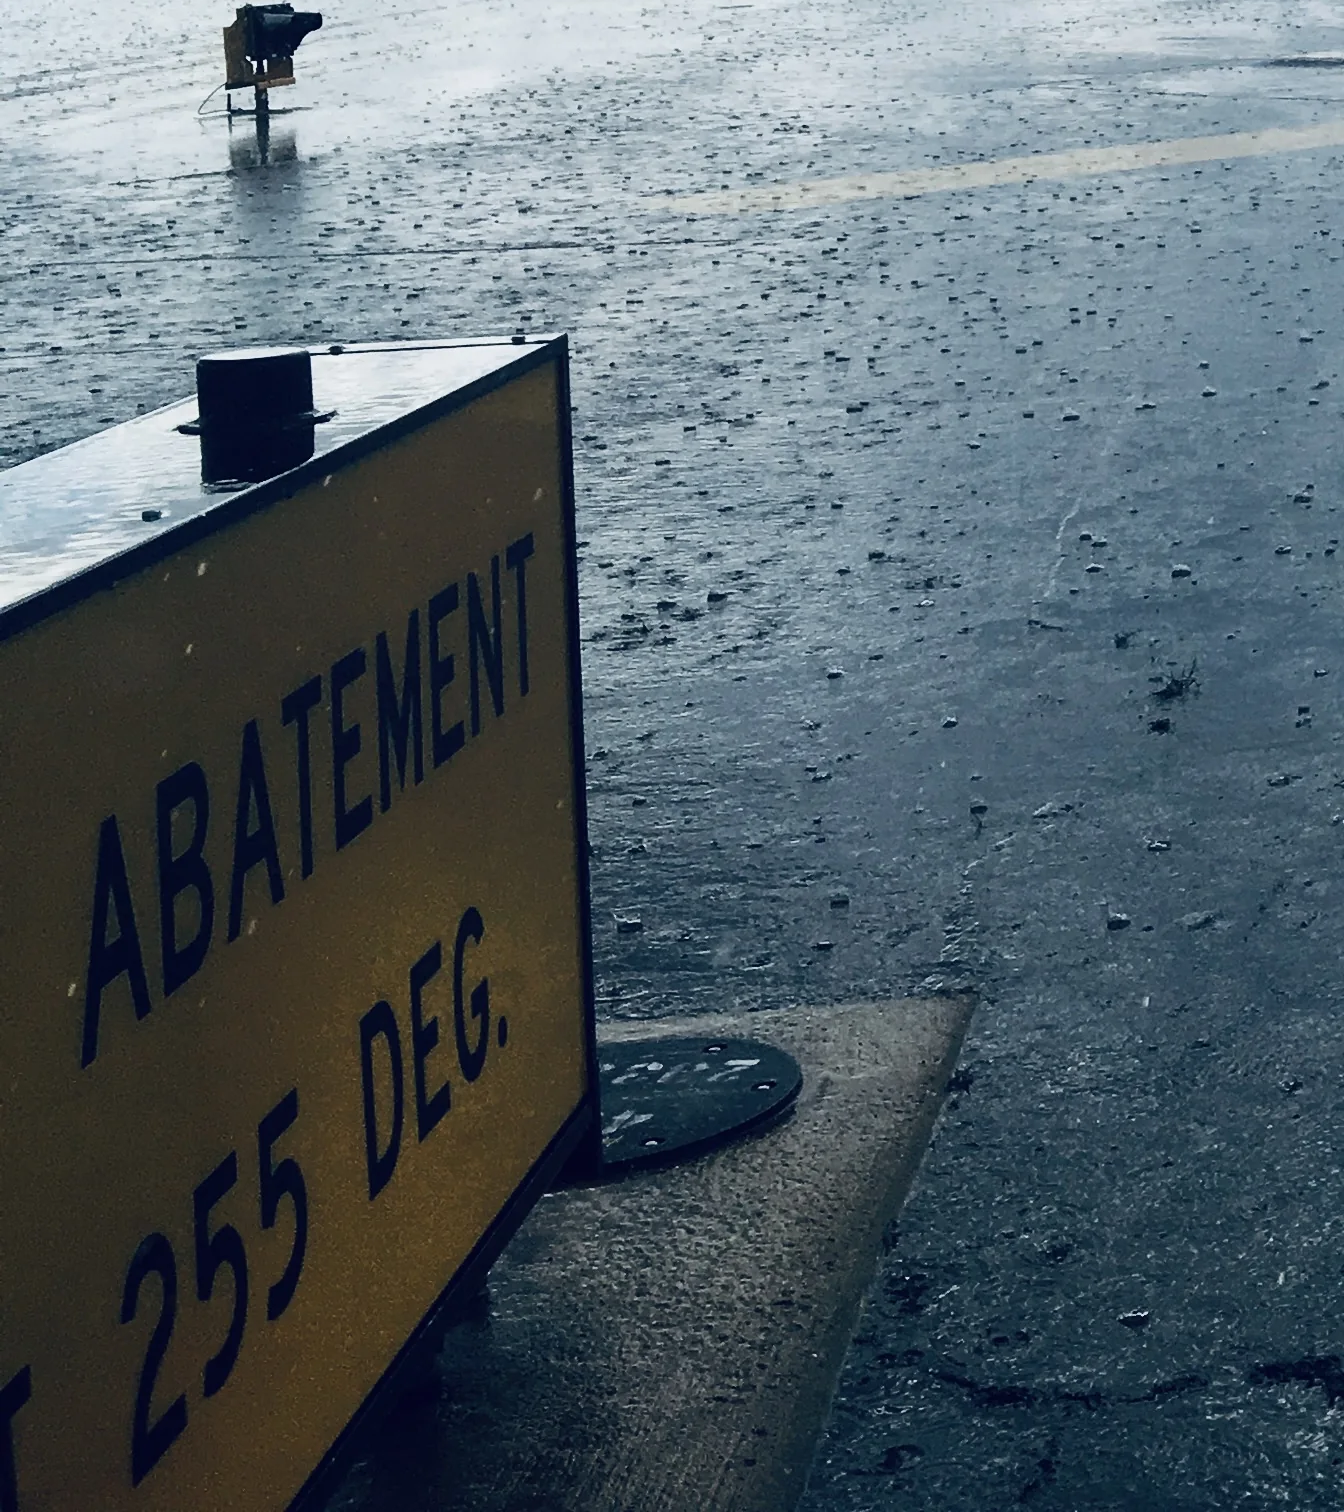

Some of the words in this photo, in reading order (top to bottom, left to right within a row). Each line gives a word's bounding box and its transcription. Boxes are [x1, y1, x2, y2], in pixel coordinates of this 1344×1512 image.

[79, 531, 534, 1072] ABATEMENT
[118, 1088, 310, 1489] 255
[358, 905, 509, 1202] DEG.
